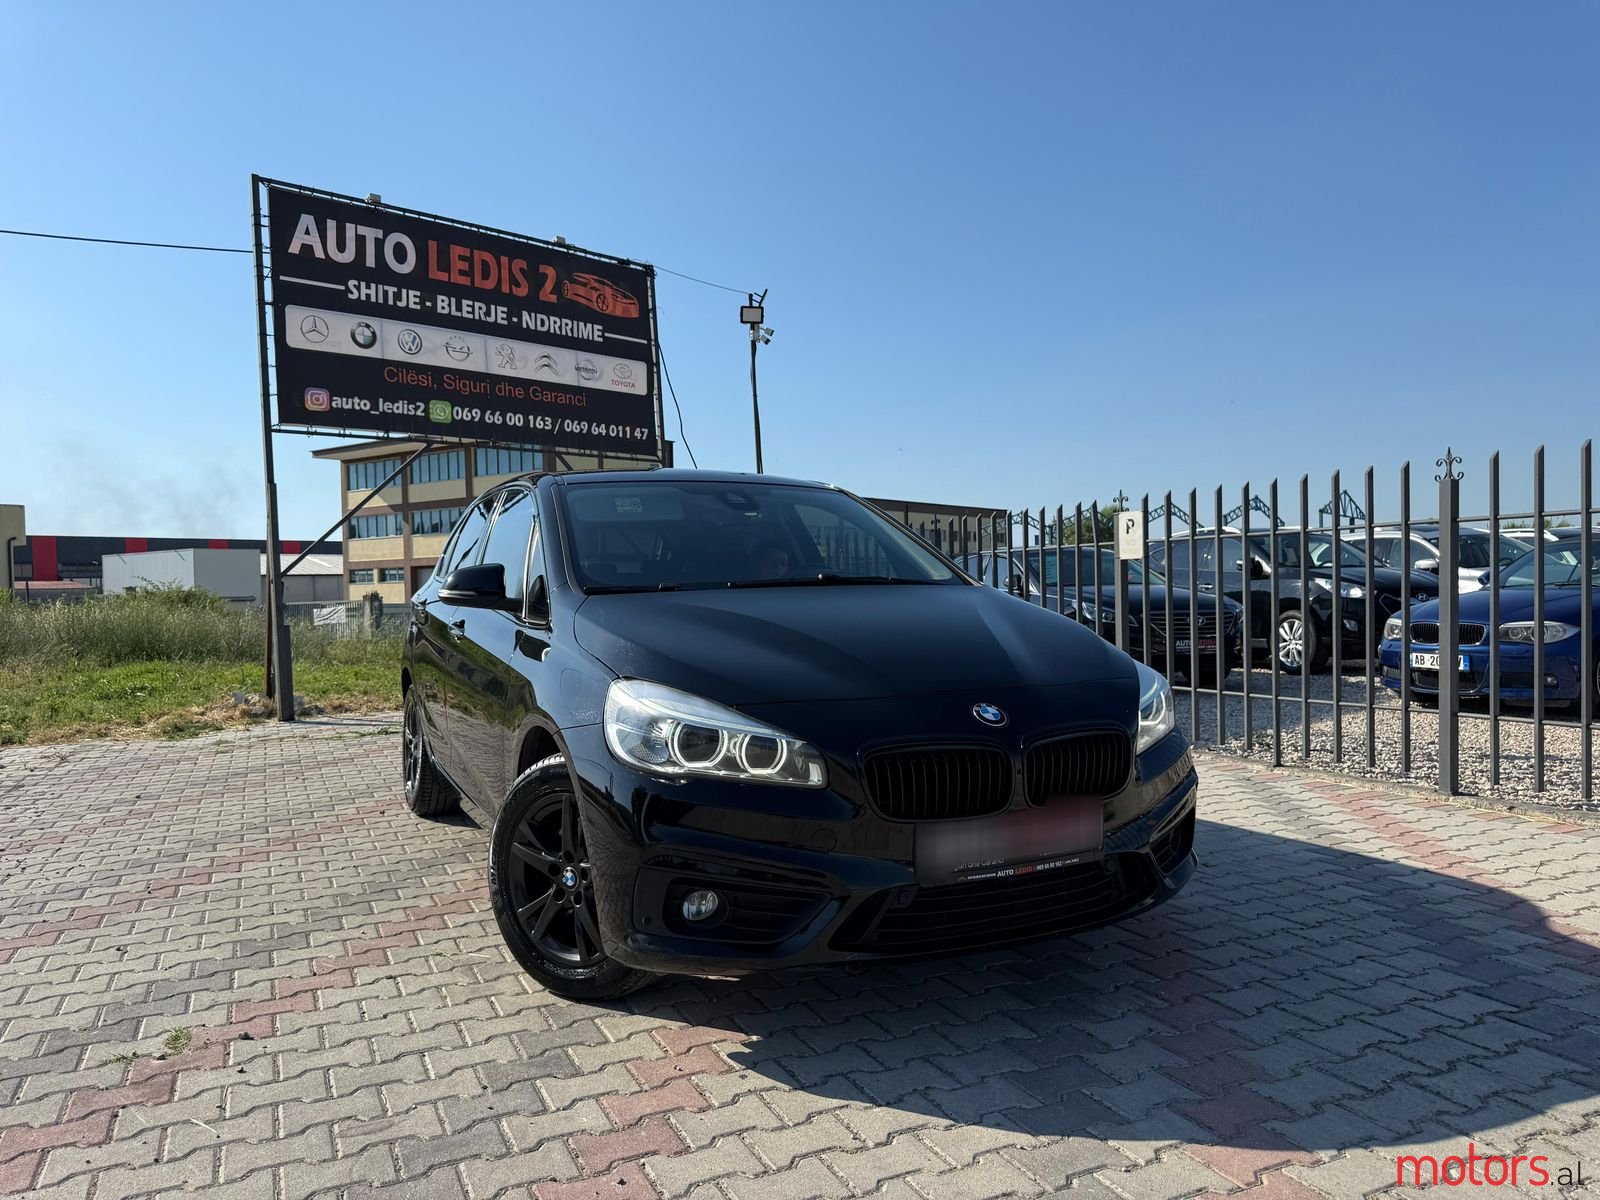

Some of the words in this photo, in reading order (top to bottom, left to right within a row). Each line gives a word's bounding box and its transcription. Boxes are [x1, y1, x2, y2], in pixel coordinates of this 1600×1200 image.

[288, 213, 417, 274] AUTO
[427, 240, 529, 297] LEDIS
[539, 264, 558, 303] 2
[347, 279, 421, 310] SHITJE
[436, 295, 508, 325] BLERJE
[522, 311, 604, 342] NDRRIME
[384, 367, 437, 390] Cilësi,
[495, 381, 525, 399] dhe
[529, 386, 587, 407] Garanci
[611, 380, 636, 388] TOYOTA
[331, 396, 425, 416] auto_ledis2
[453, 406, 481, 422] 069
[485, 410, 503, 425] 66
[506, 412, 524, 427] 00
[528, 415, 552, 430] 163
[553, 418, 562, 435] /
[564, 419, 588, 434] 069
[591, 422, 607, 436] 64
[609, 424, 631, 439] 011
[634, 427, 649, 440] 47
[1415, 654, 1425, 666] AB
[997, 868, 1014, 877] AUTO
